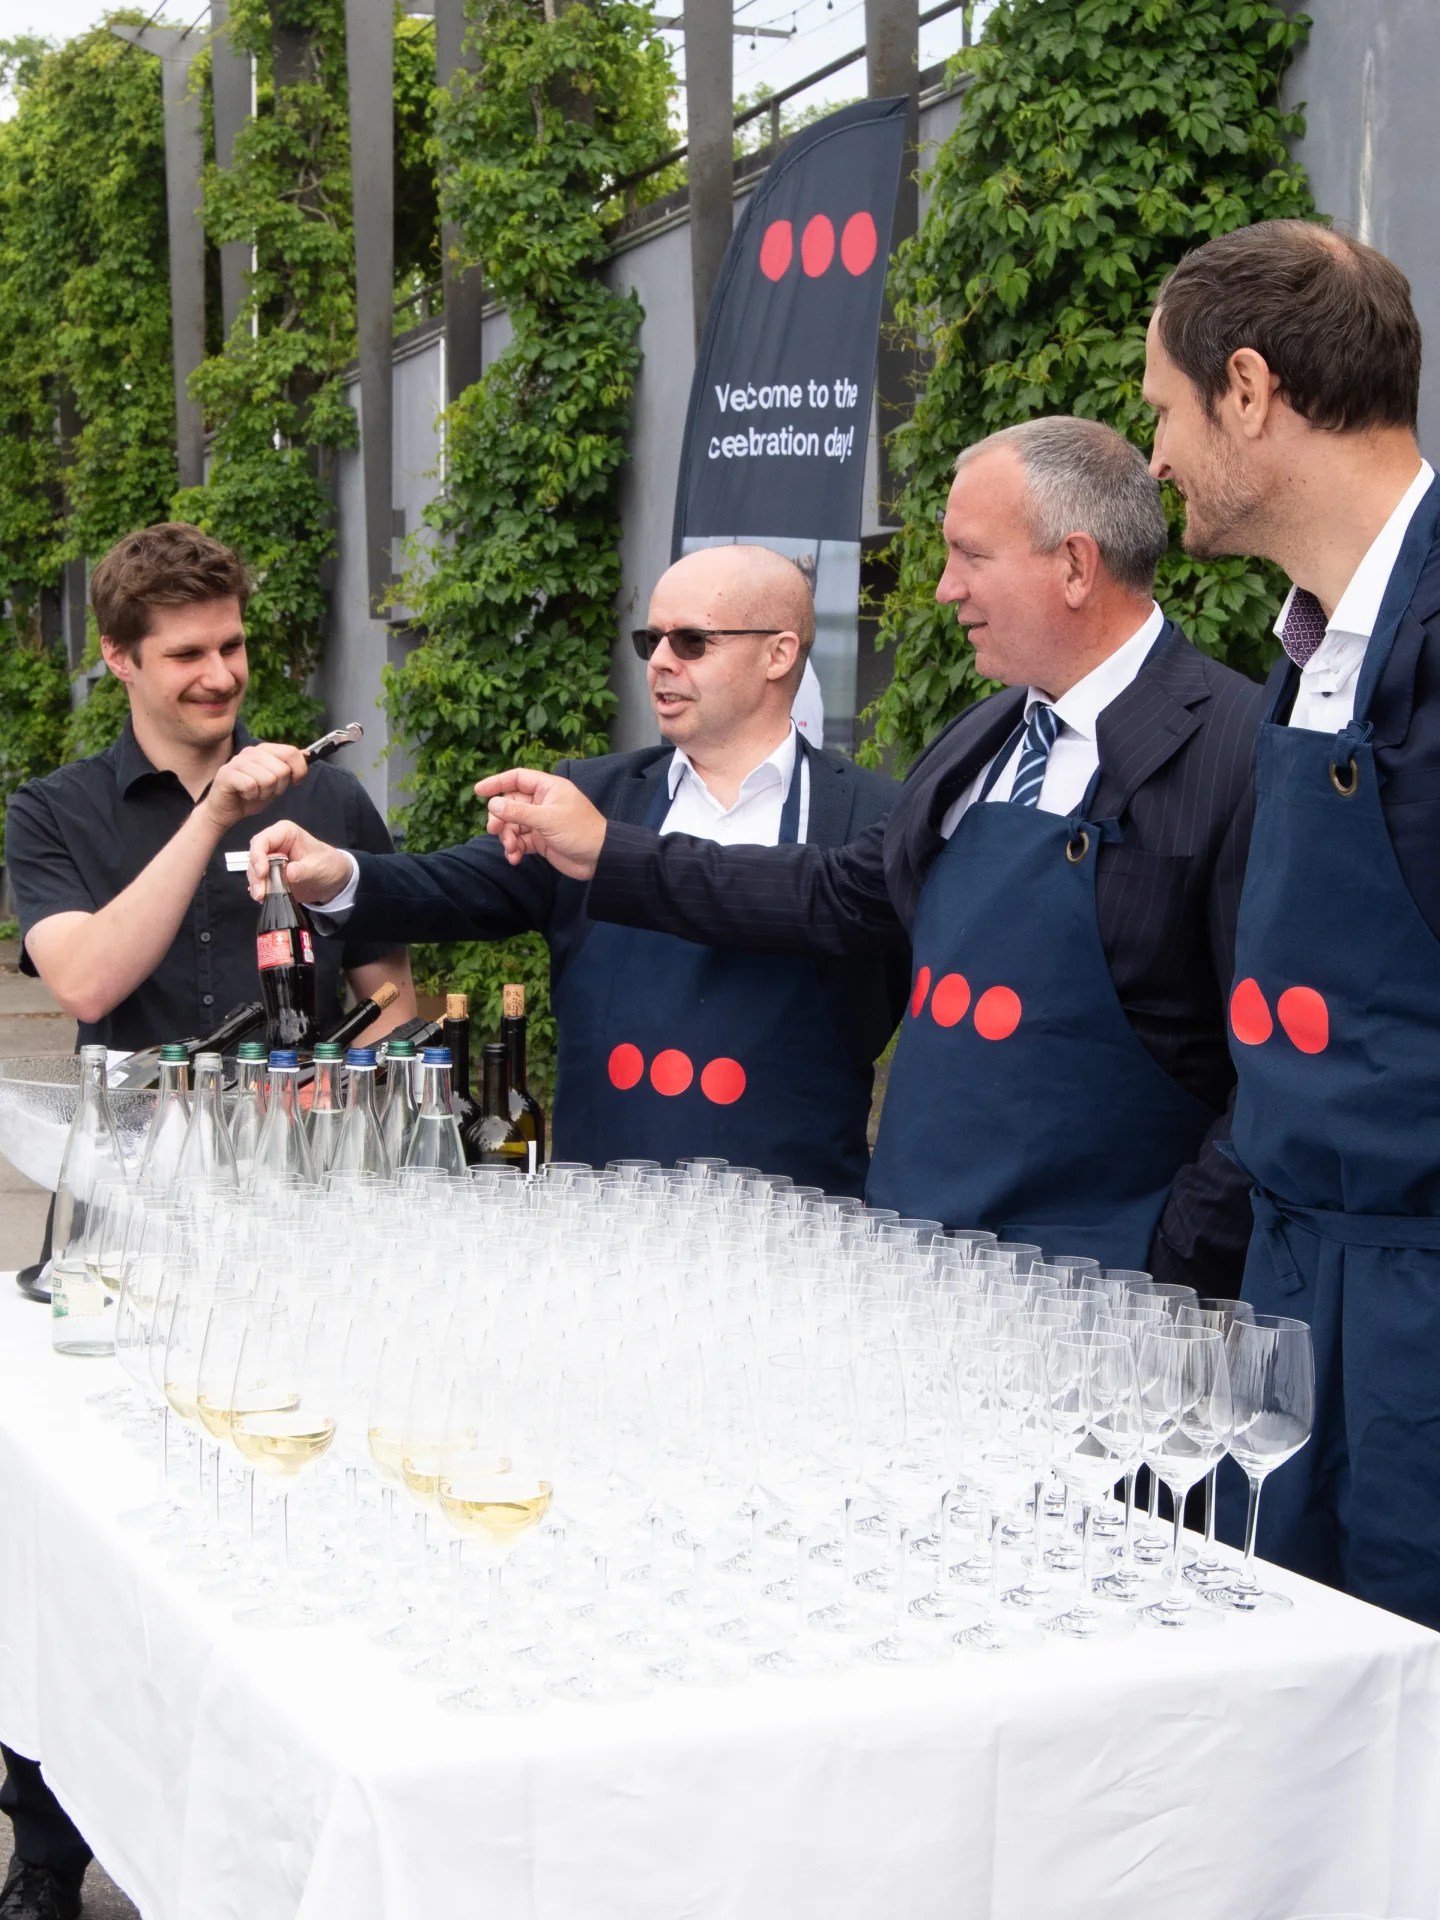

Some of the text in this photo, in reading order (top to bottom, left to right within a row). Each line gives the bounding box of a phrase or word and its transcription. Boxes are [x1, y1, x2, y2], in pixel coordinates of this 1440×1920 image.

[714, 377, 859, 413] ecome to the
[707, 424, 855, 464] ceebration day!
